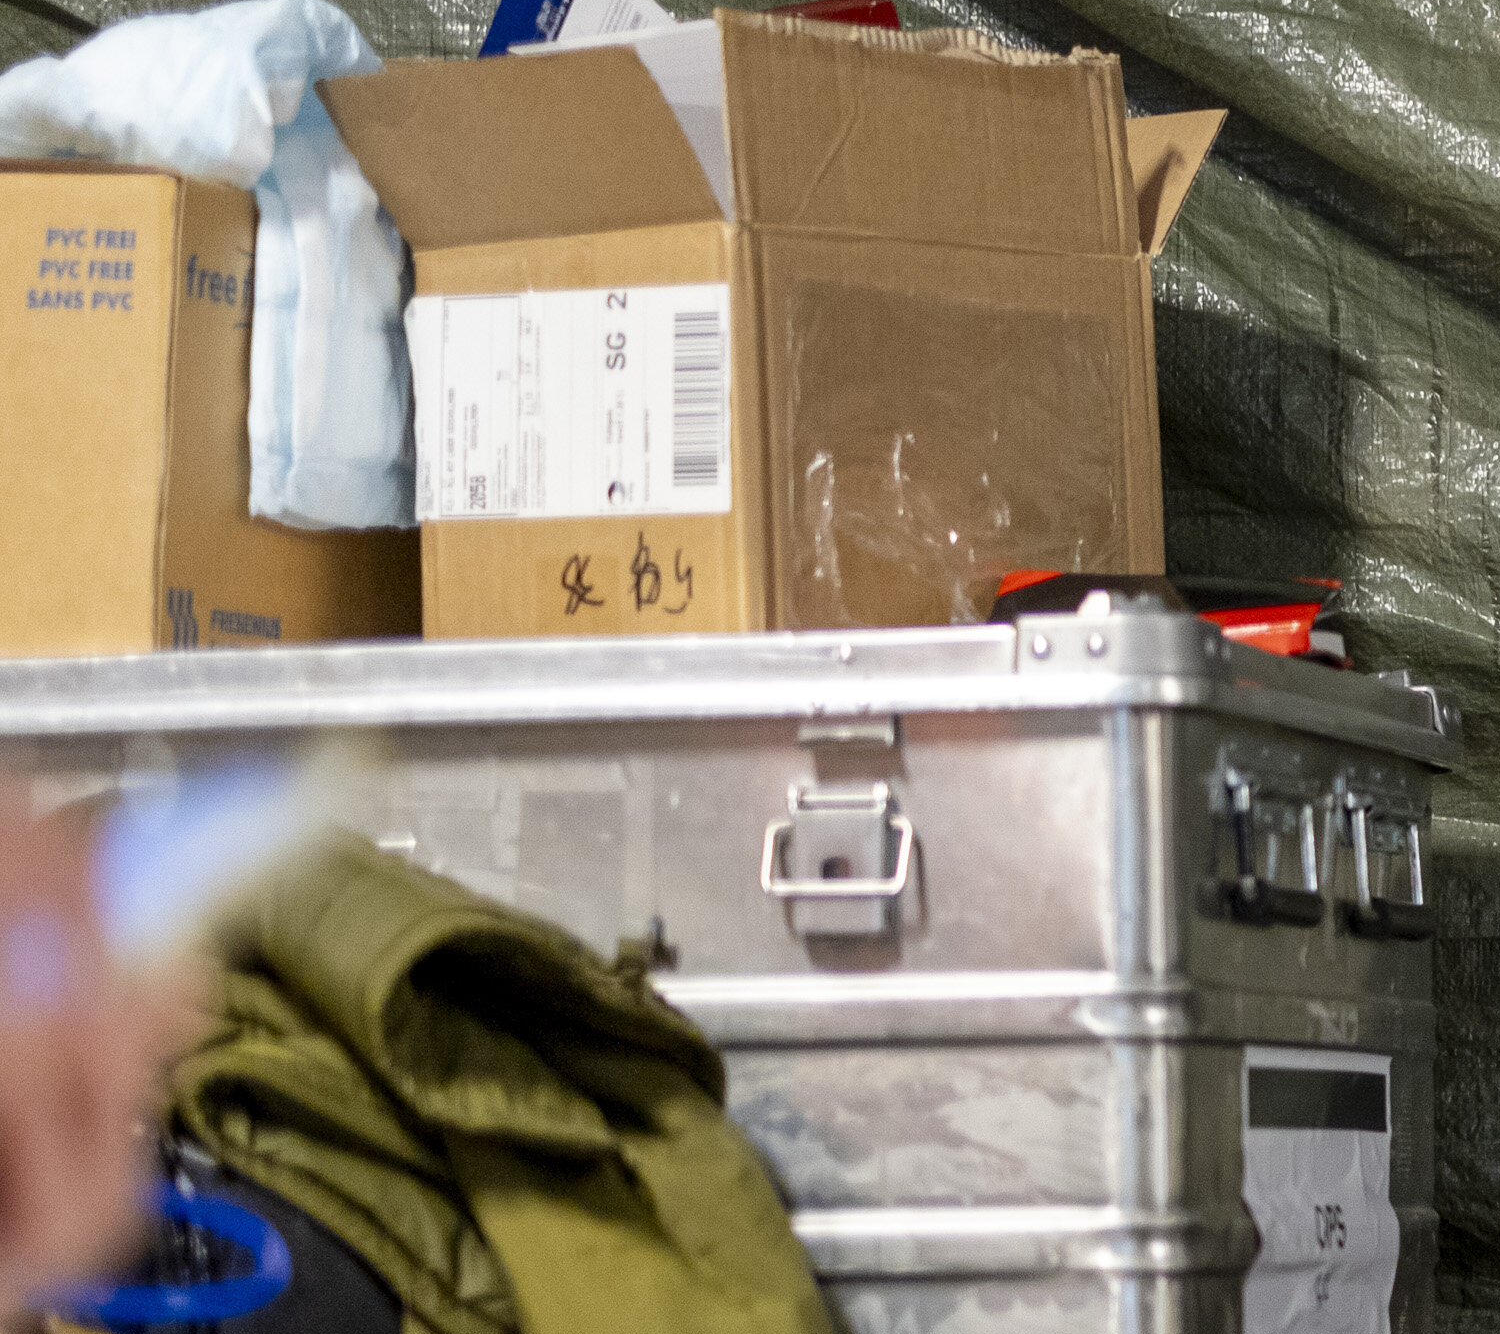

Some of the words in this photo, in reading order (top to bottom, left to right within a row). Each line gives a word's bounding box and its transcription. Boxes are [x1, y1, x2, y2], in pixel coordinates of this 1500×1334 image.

[46, 228, 87, 249] PVC
[93, 228, 138, 250] FREI
[38, 258, 81, 280] PVC
[87, 259, 135, 281] FREE
[25, 288, 85, 311] SANS
[90, 289, 134, 312] PVC
[606, 289, 628, 311] 2
[605, 331, 627, 371] SG
